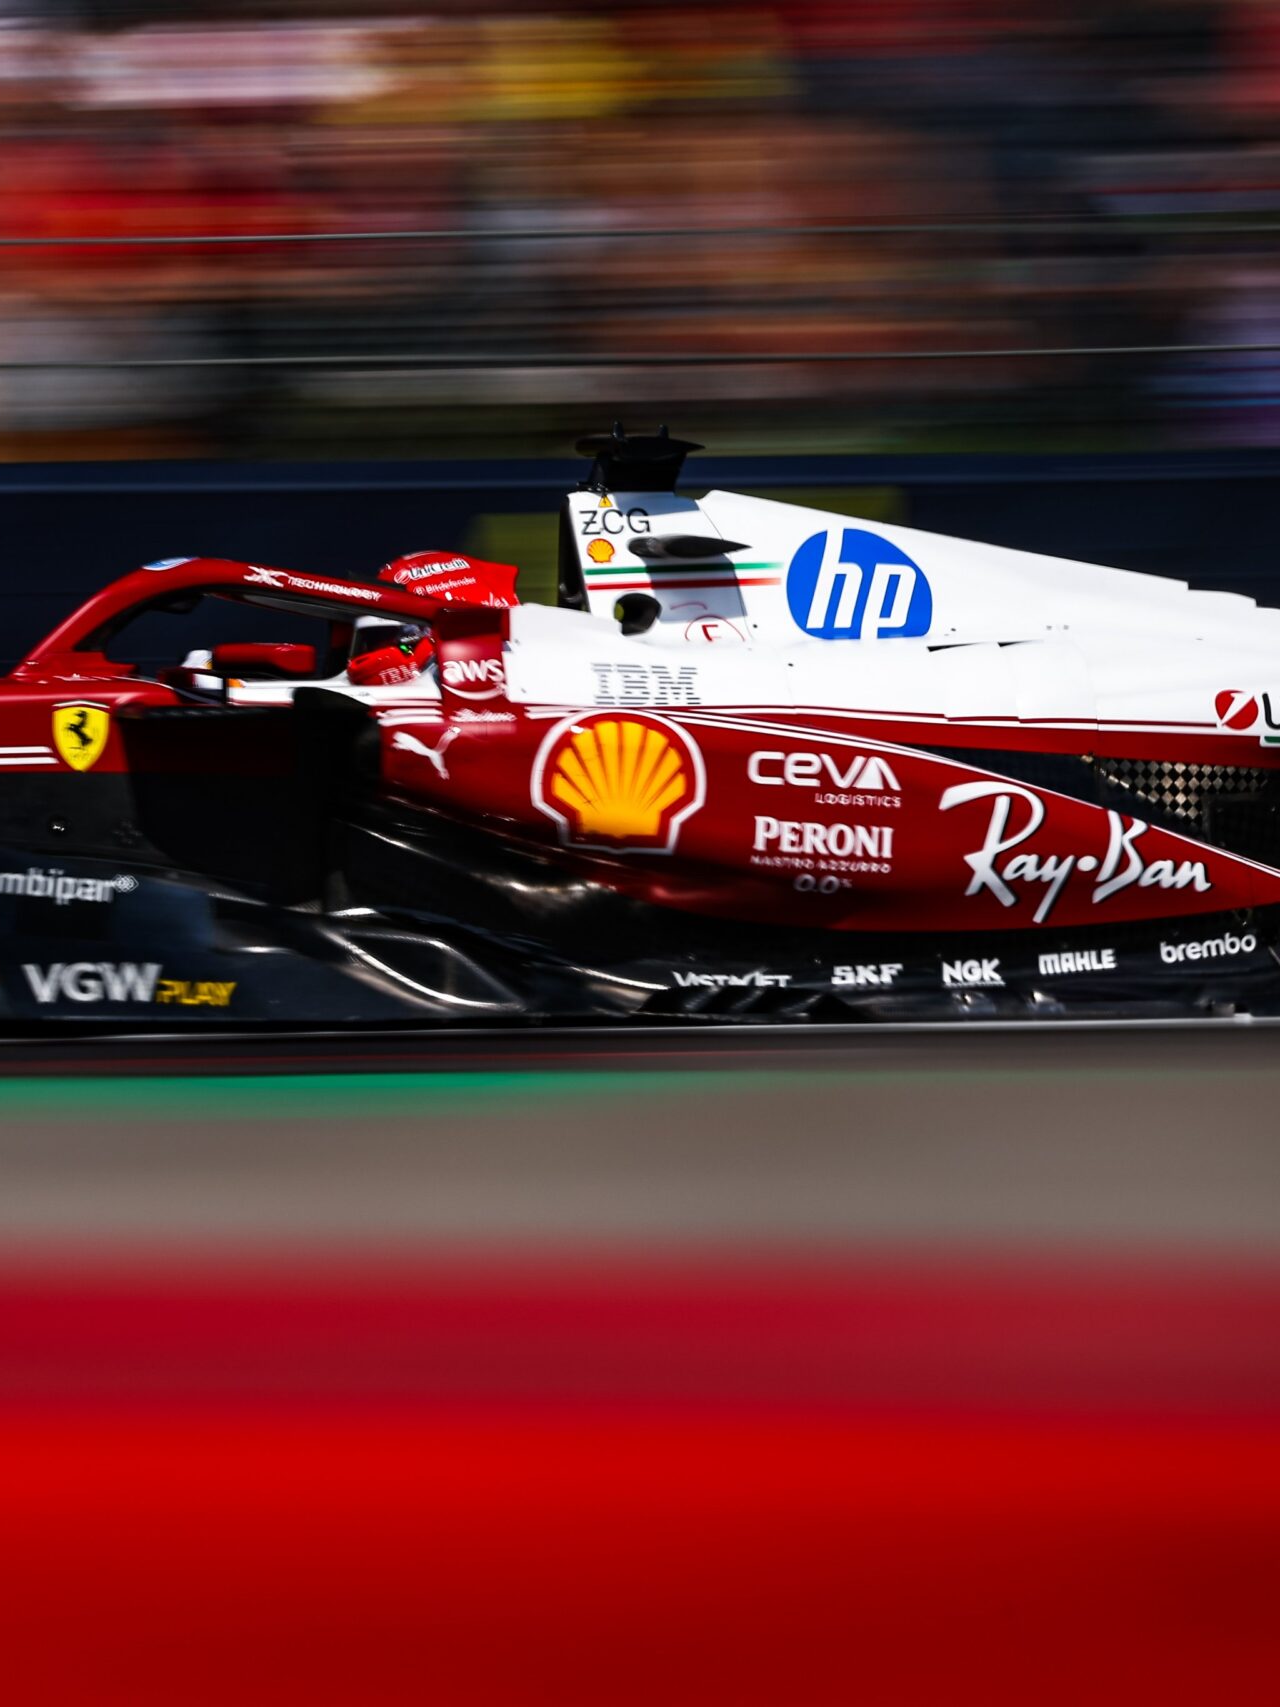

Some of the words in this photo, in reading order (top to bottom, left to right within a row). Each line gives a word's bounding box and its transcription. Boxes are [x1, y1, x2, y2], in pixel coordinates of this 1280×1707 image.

[805, 529, 918, 639] hp
[441, 658, 505, 684] aws
[591, 662, 702, 705] IBM
[814, 792, 902, 808] LOGISTICS
[752, 815, 895, 859] PERONI
[1038, 949, 1117, 976] MAHLE
[1160, 932, 1257, 964] brembo
[831, 963, 904, 986] SKF
[942, 957, 1003, 986] NGK
